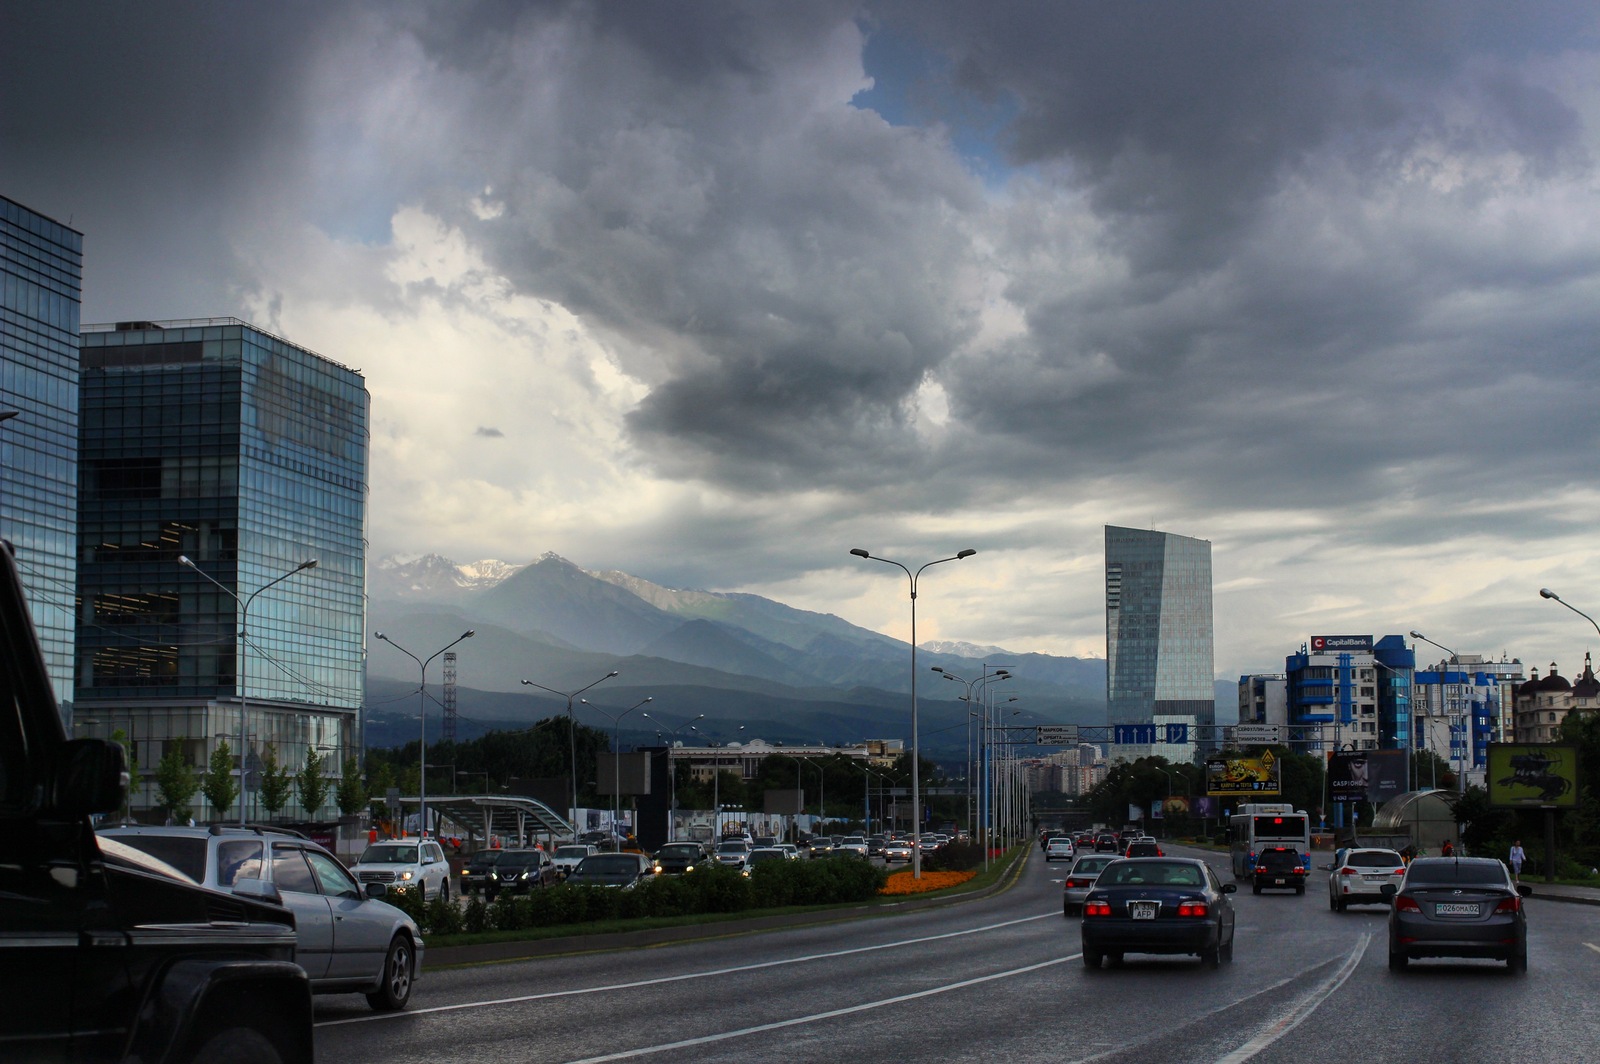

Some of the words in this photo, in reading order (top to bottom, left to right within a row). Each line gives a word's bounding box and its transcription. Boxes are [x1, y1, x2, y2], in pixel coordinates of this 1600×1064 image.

[1327, 639, 1367, 647] CapitalBank
[1260, 782, 1266, 790] 7
[1136, 910, 1152, 918] AFP
